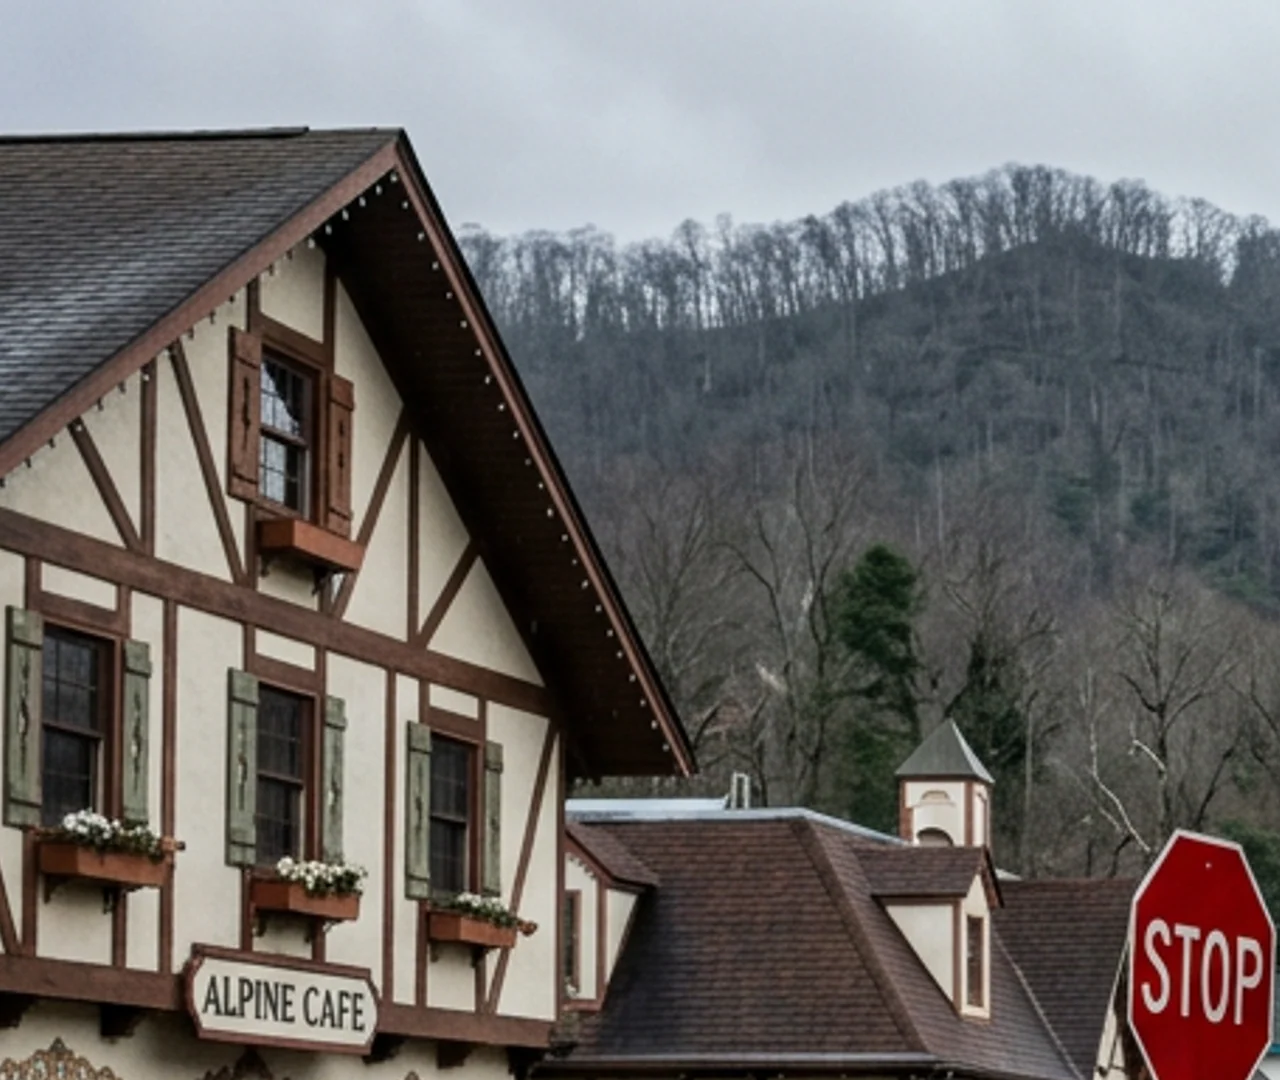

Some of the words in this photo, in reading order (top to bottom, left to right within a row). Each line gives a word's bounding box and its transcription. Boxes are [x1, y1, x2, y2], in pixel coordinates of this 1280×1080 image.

[202, 975, 296, 1023] ALPINE
[303, 986, 366, 1032] CAFE
[1141, 918, 1263, 1026] STOP
